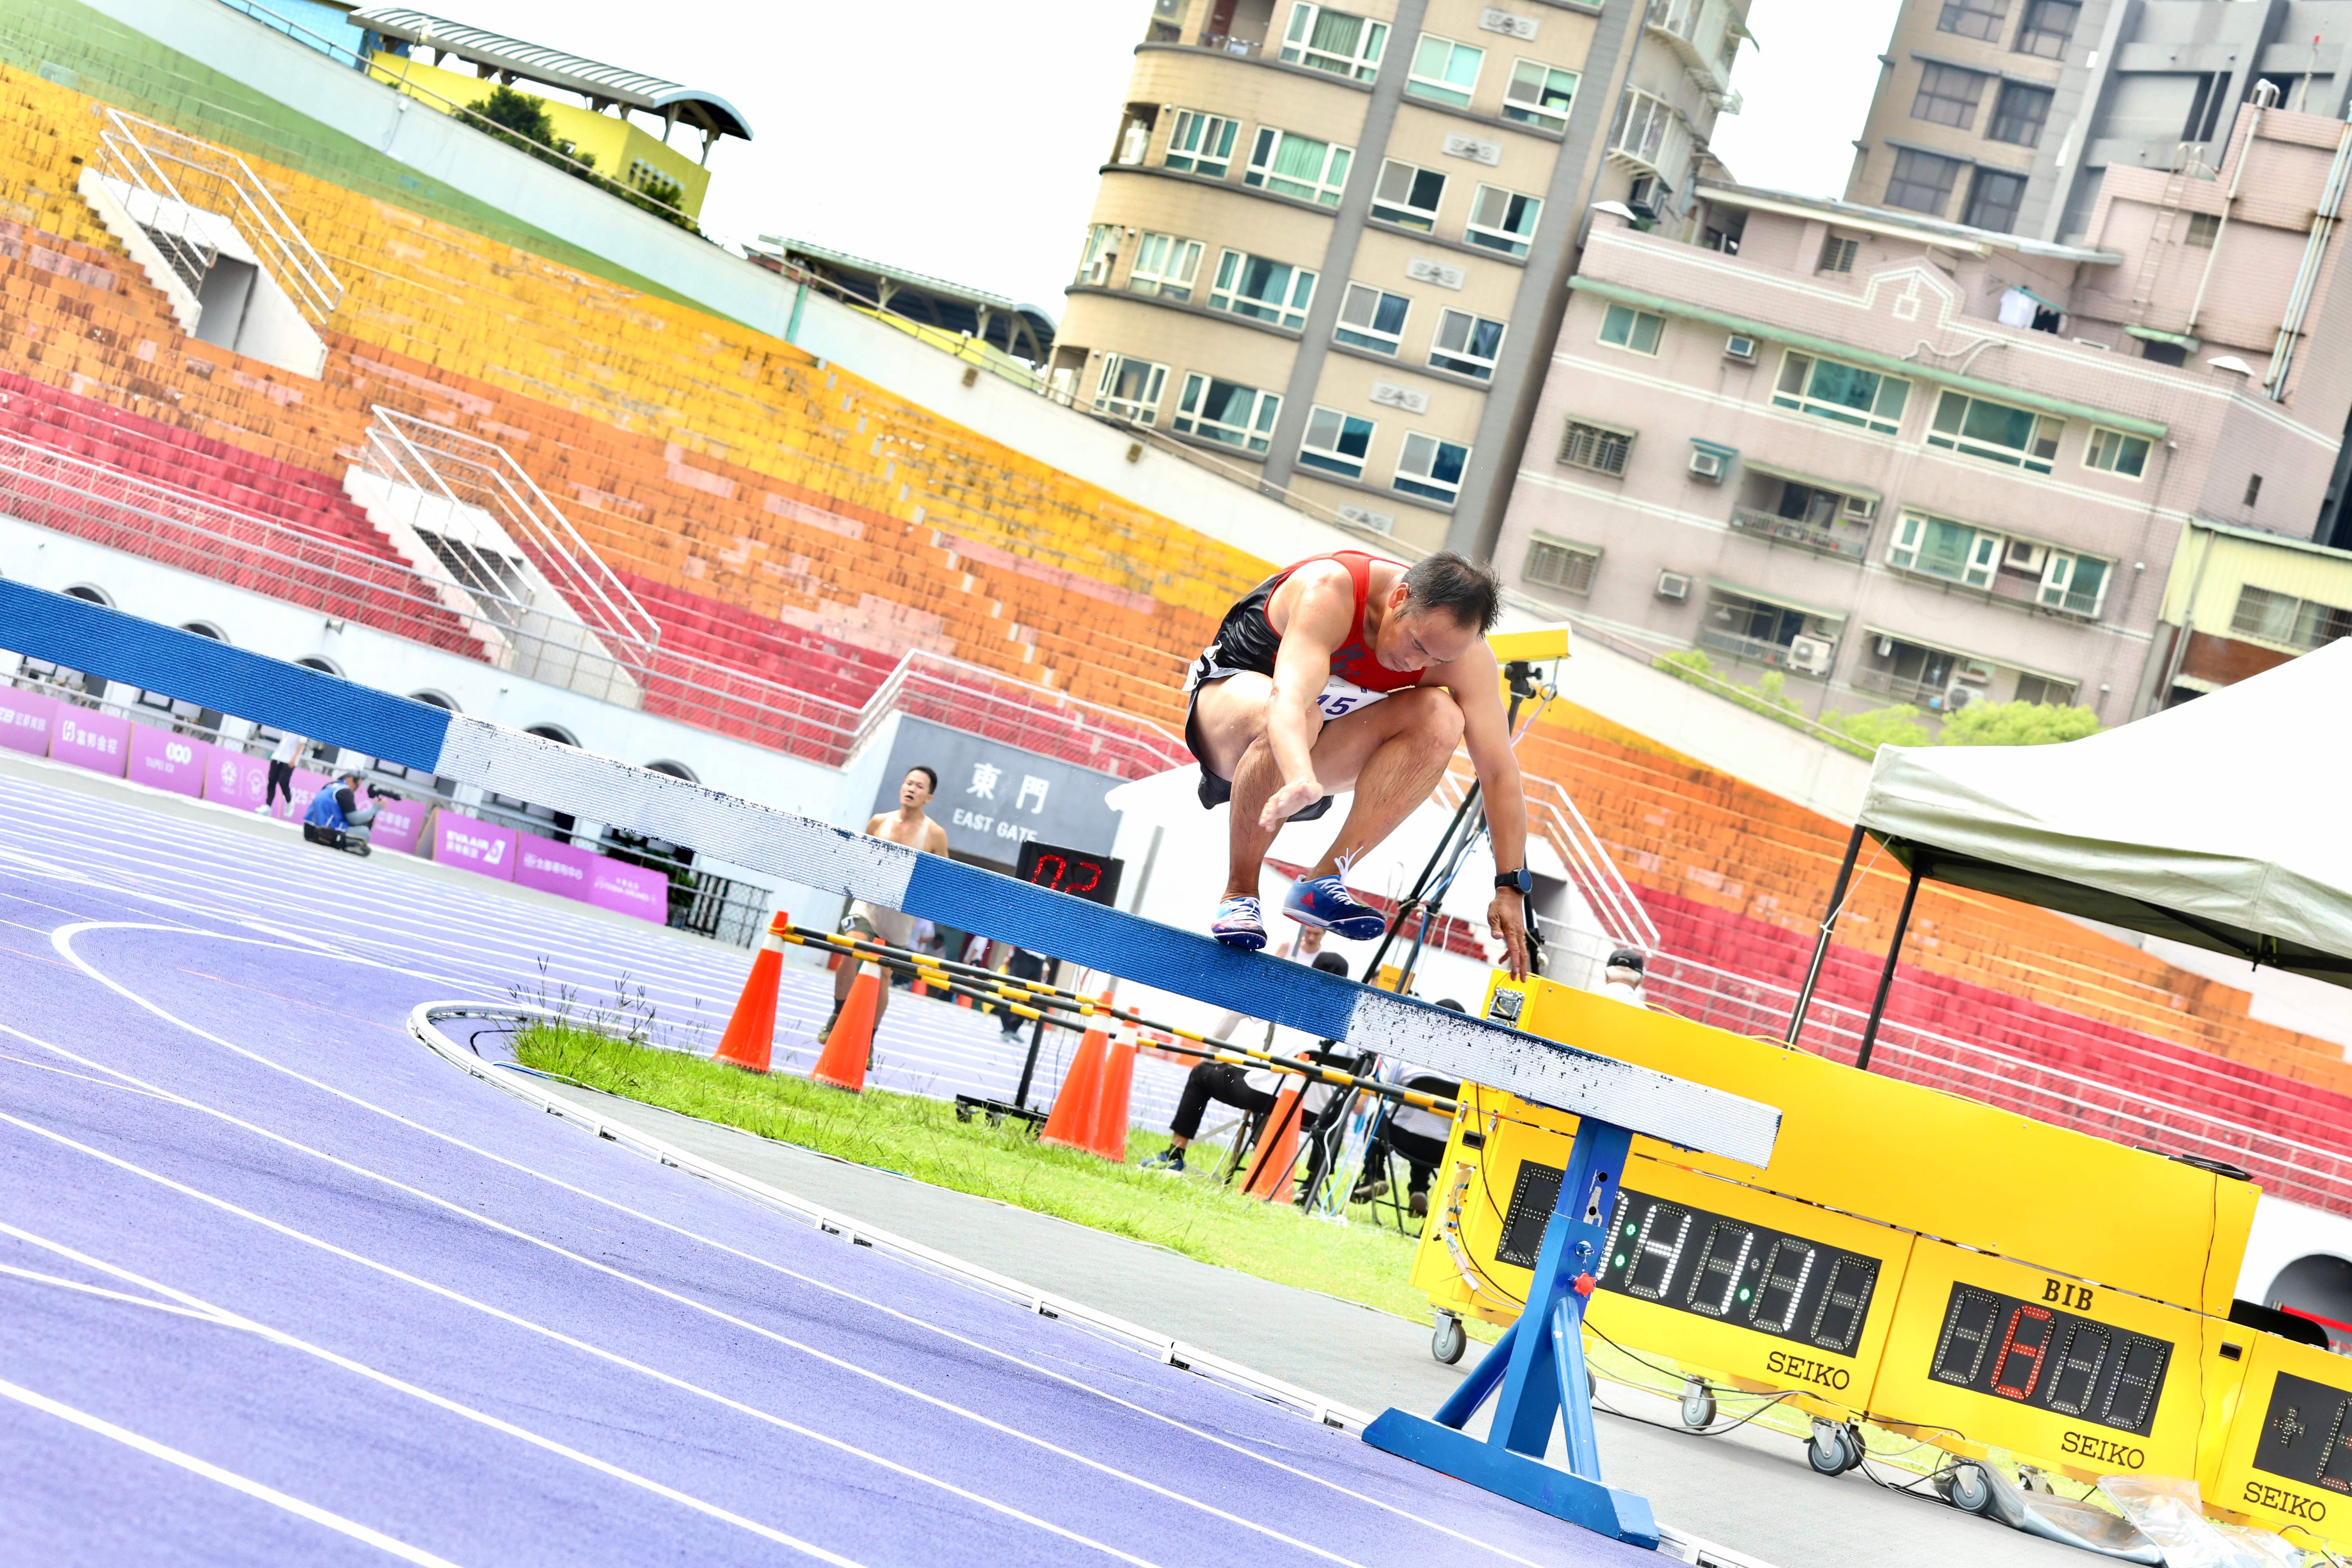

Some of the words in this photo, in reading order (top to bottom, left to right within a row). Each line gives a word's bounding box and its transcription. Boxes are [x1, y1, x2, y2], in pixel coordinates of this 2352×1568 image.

[966, 762, 1051, 815] 東門
[952, 808, 995, 833] EAST
[996, 821, 1039, 842] GATE
[2042, 1278, 2094, 1311] BIB
[1766, 1351, 1850, 1390] SEIKO
[2061, 1432, 2145, 1470] SEIKO
[2243, 1481, 2326, 1522] SEIKO
